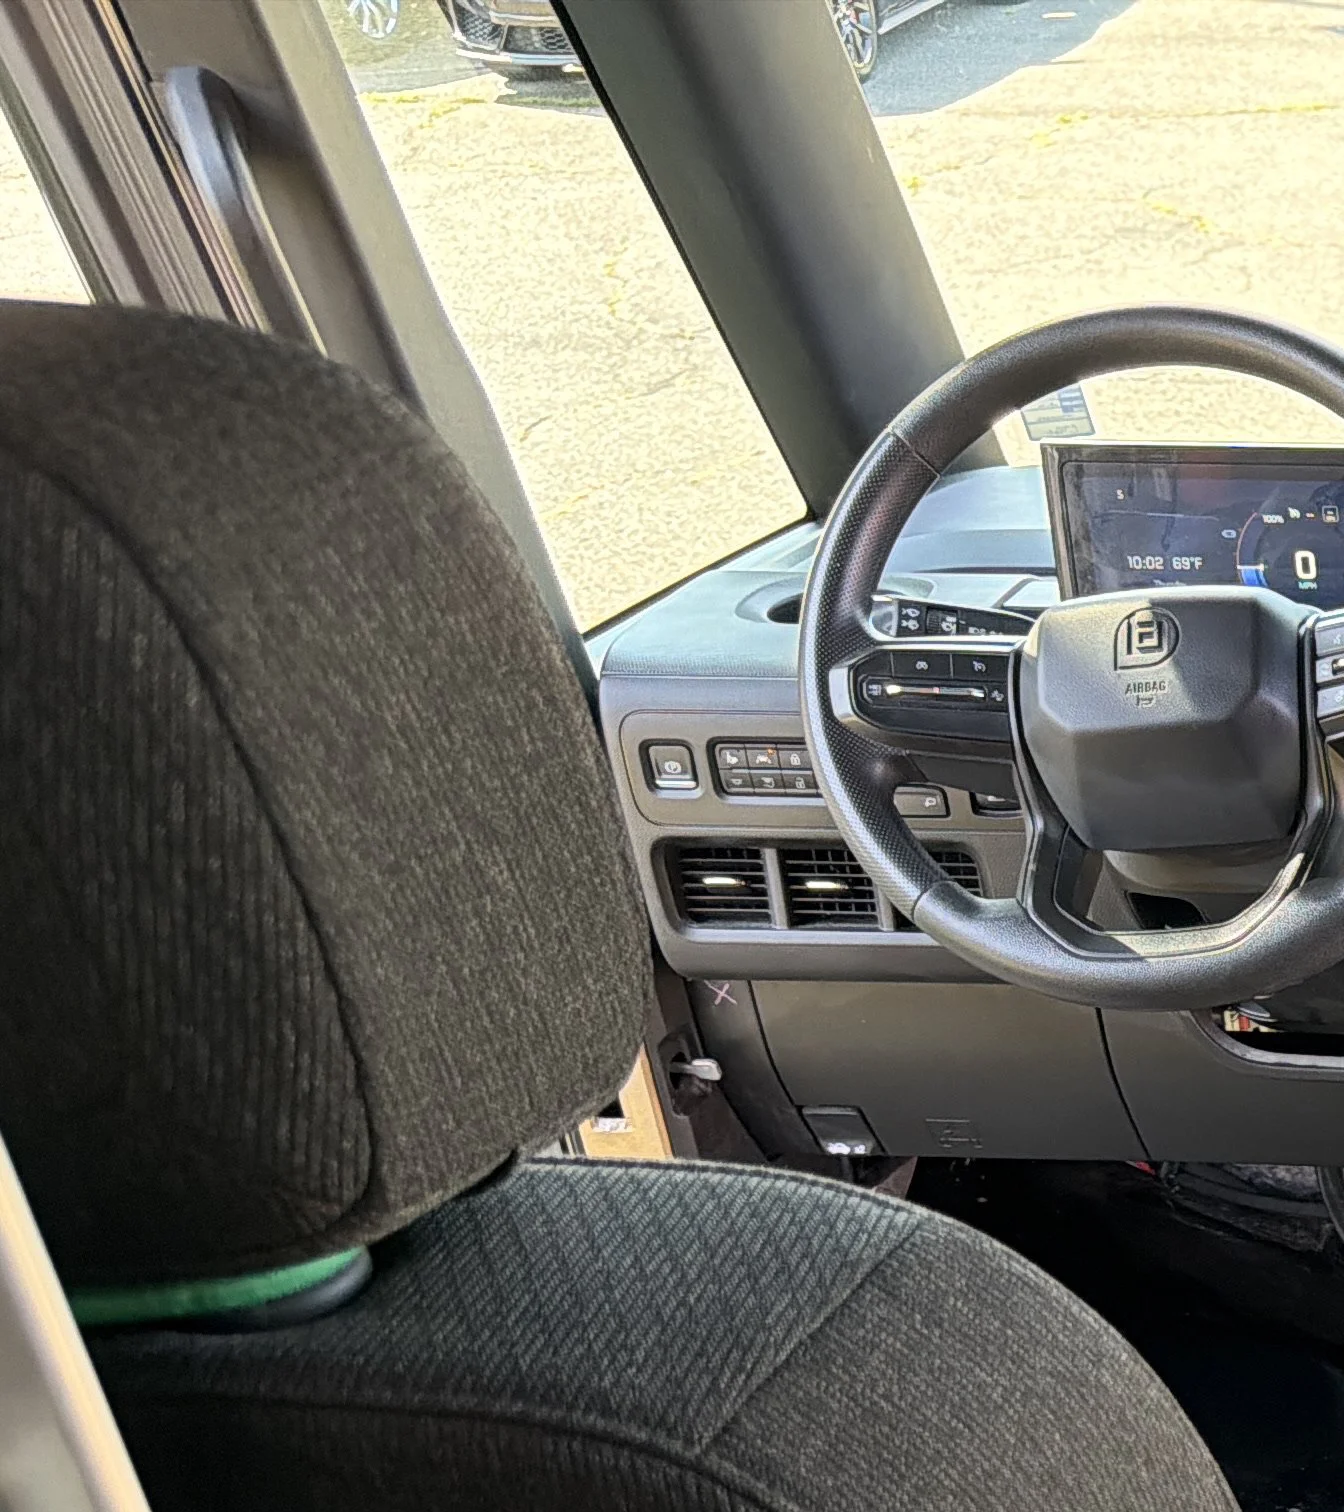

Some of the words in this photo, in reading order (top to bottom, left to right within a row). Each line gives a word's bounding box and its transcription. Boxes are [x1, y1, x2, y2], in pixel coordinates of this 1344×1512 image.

[1127, 555, 1164, 570] 10:02
[1172, 555, 1203, 570] 69°F
[1294, 550, 1317, 580] 0
[1298, 581, 1318, 590] MPH
[1125, 681, 1166, 694] AIRBAG
